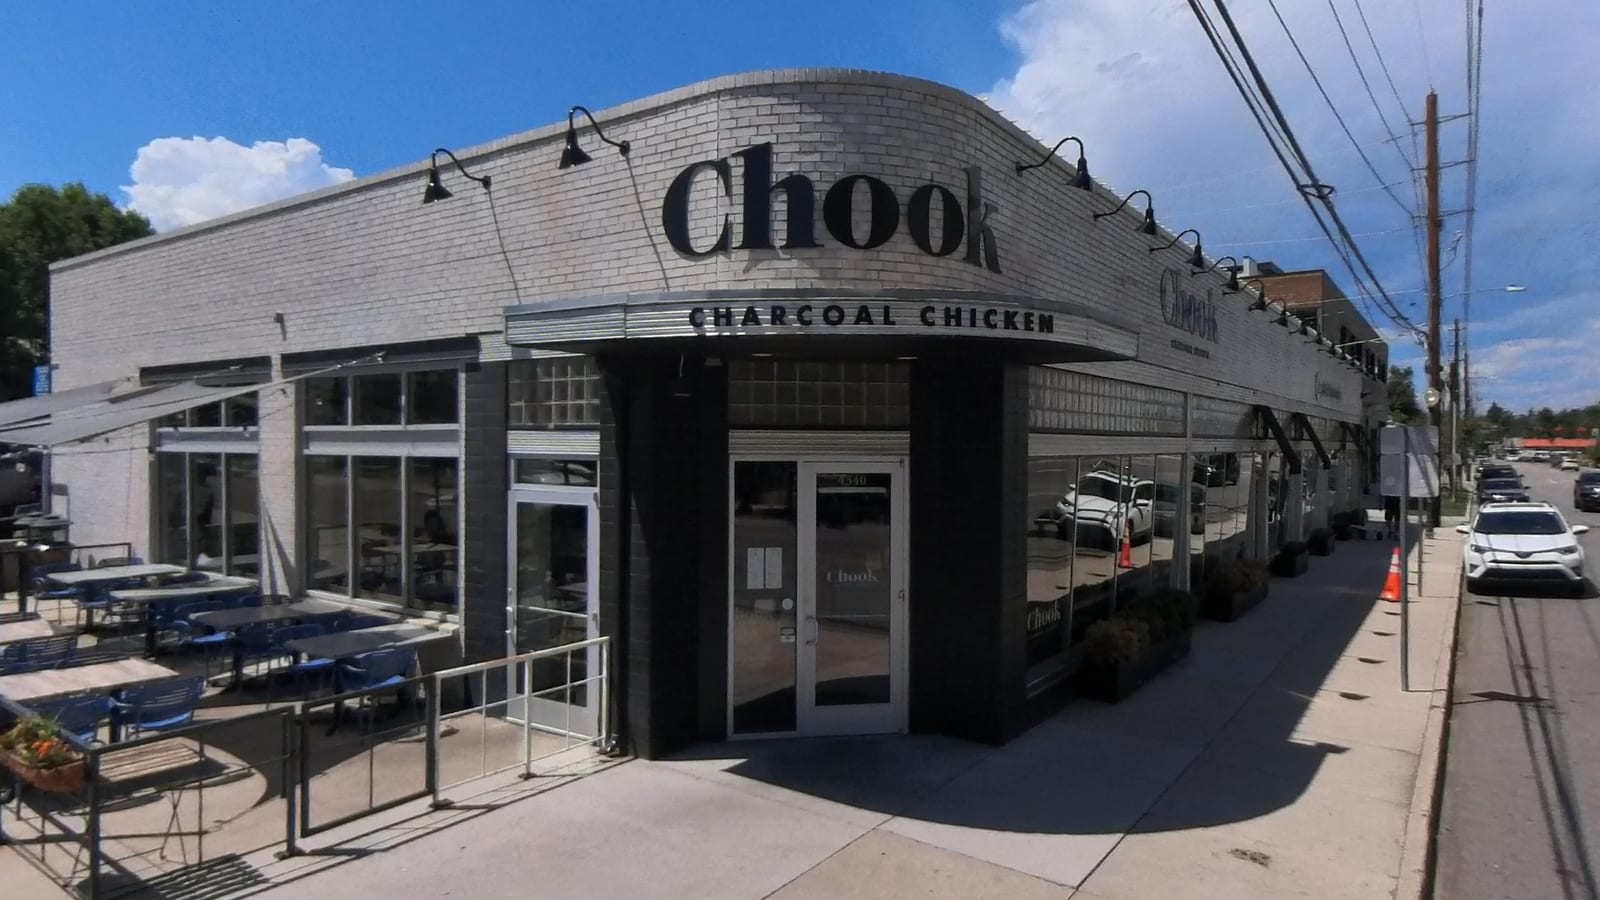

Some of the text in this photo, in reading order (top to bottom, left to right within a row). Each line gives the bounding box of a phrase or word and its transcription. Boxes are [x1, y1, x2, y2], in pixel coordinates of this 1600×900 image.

[662, 142, 1001, 273] Chook
[689, 305, 1054, 334] CHARCOAL CHICKEN
[826, 568, 878, 583] Chook
[1027, 601, 1060, 632] Chook
